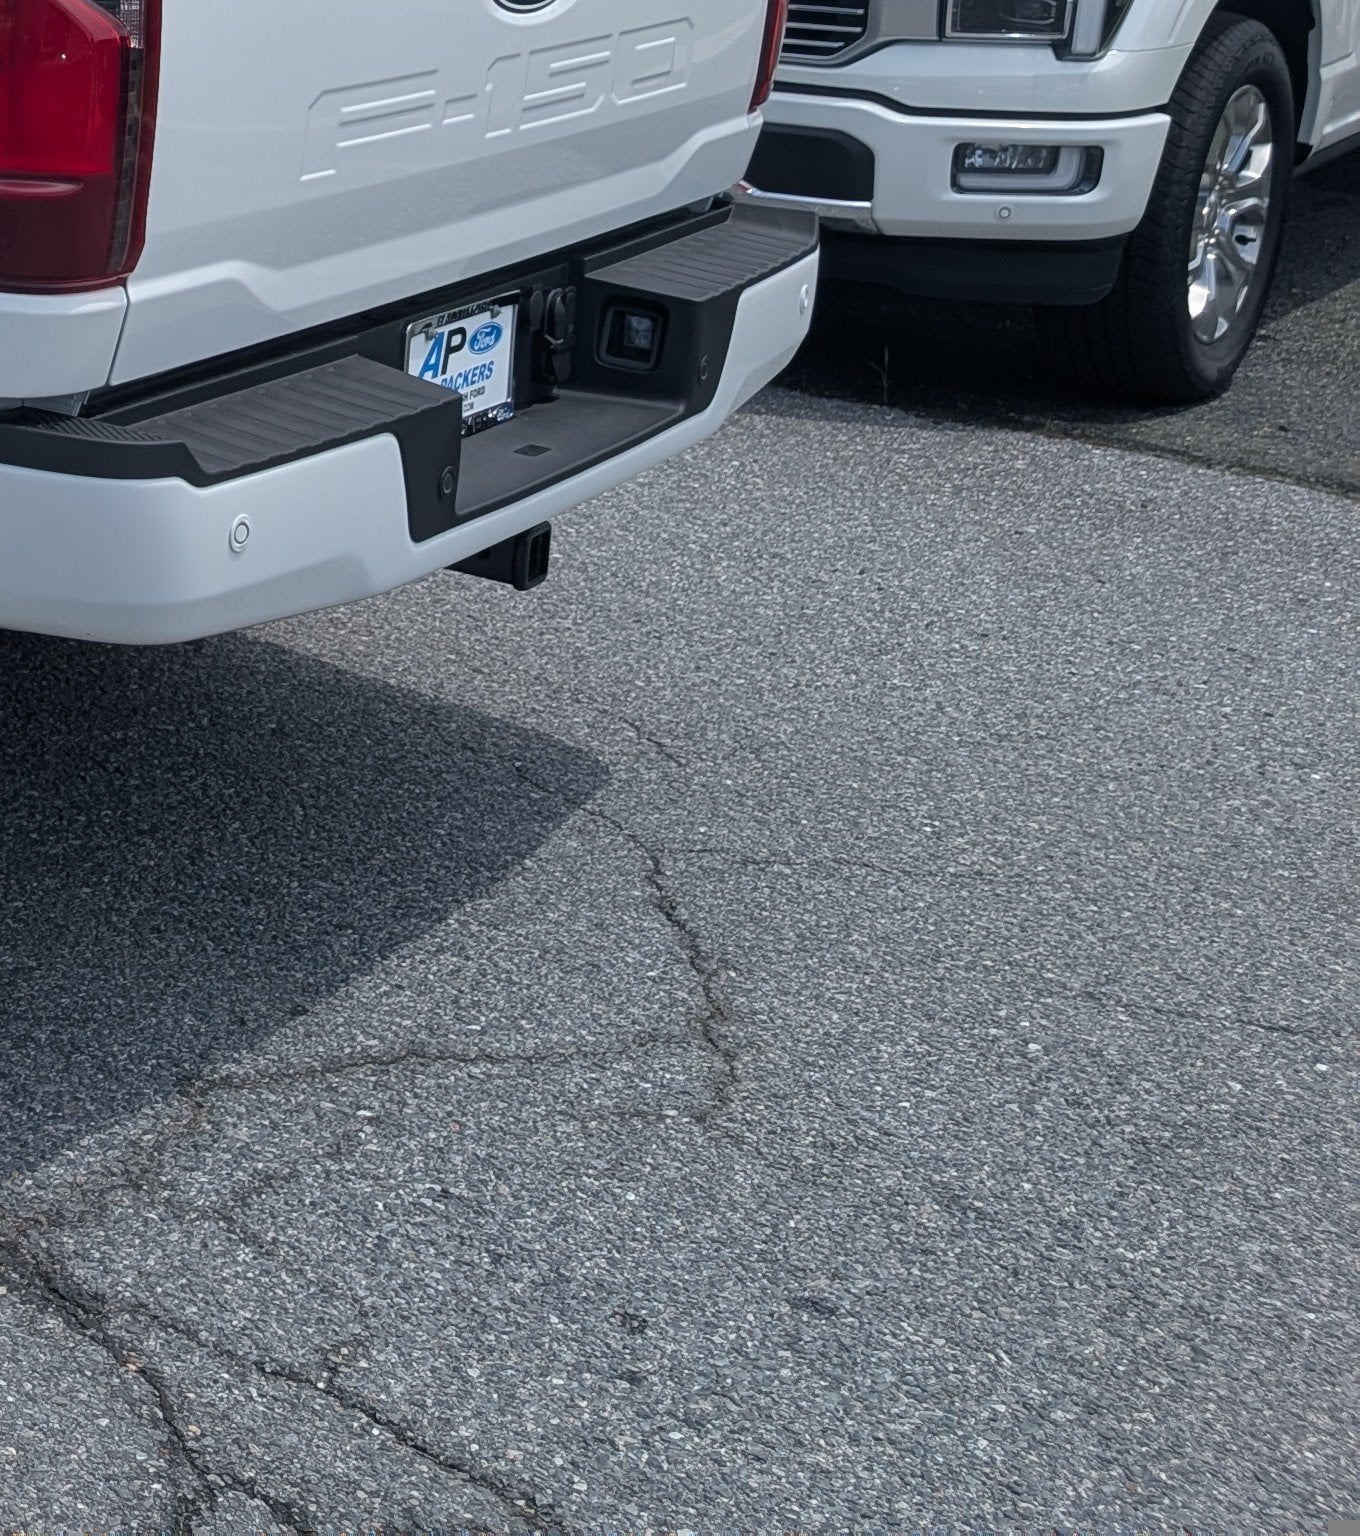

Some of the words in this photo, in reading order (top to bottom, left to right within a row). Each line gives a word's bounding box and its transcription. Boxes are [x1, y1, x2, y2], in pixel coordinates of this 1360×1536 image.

[300, 17, 694, 182] F-150
[417, 326, 467, 380] AP
[472, 325, 500, 352] Ford
